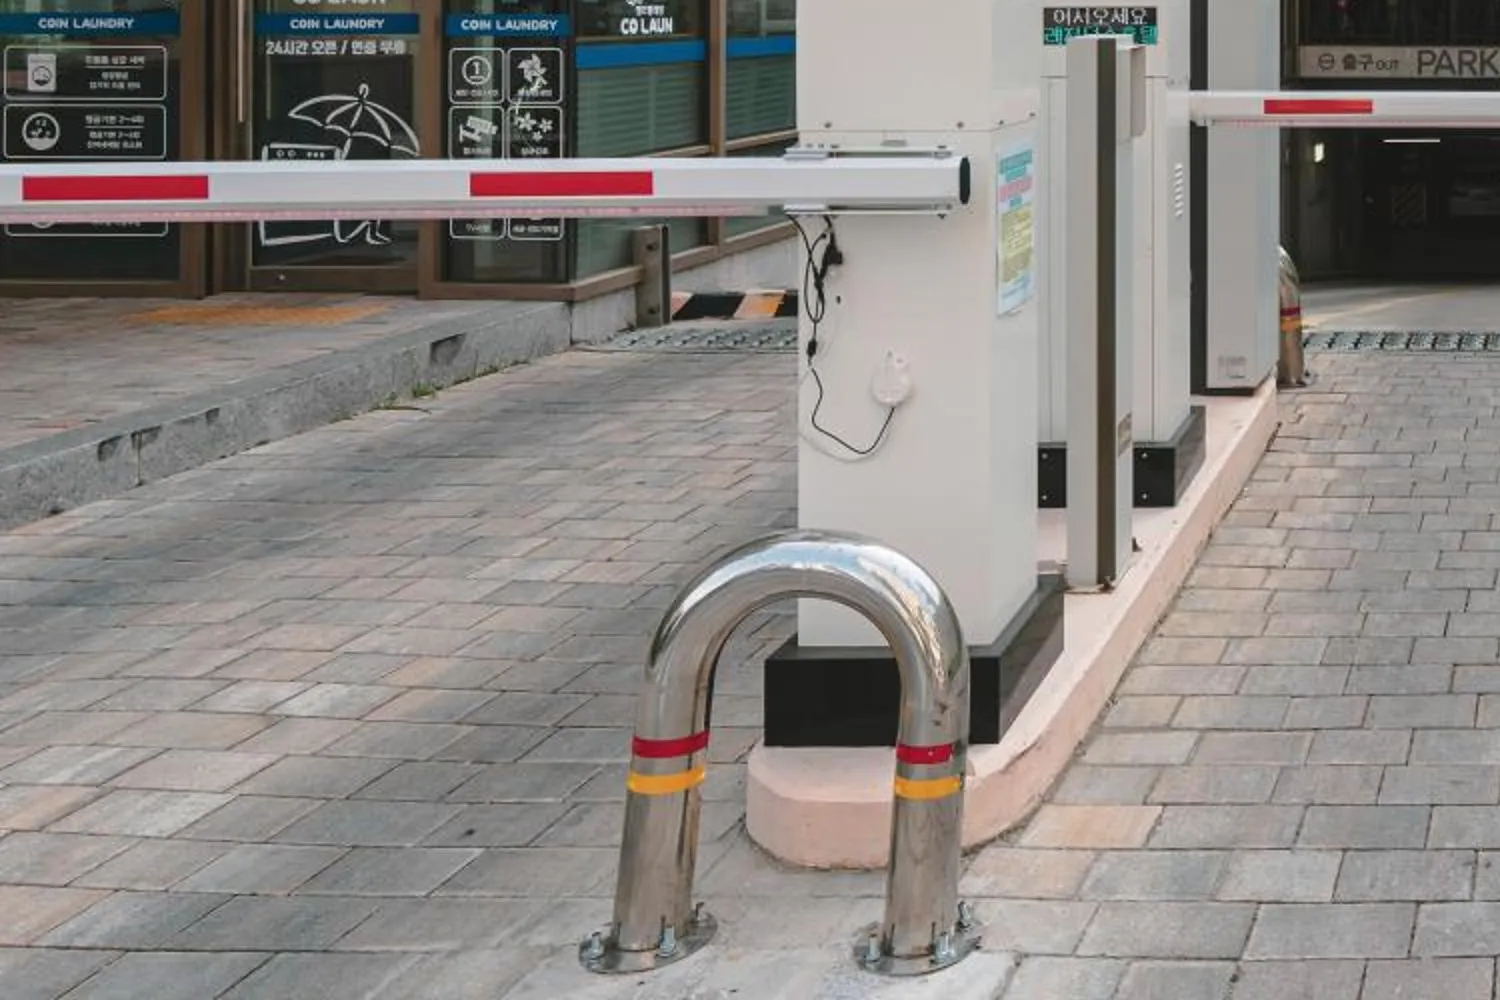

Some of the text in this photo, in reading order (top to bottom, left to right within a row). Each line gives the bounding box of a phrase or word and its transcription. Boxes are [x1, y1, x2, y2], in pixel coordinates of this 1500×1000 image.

[38, 17, 135, 29] COIN LAUNDRY
[289, 18, 386, 30] COIN LAUNDRY
[461, 19, 559, 31] COIN LAUNDRY
[620, 16, 673, 35] CO LAUN
